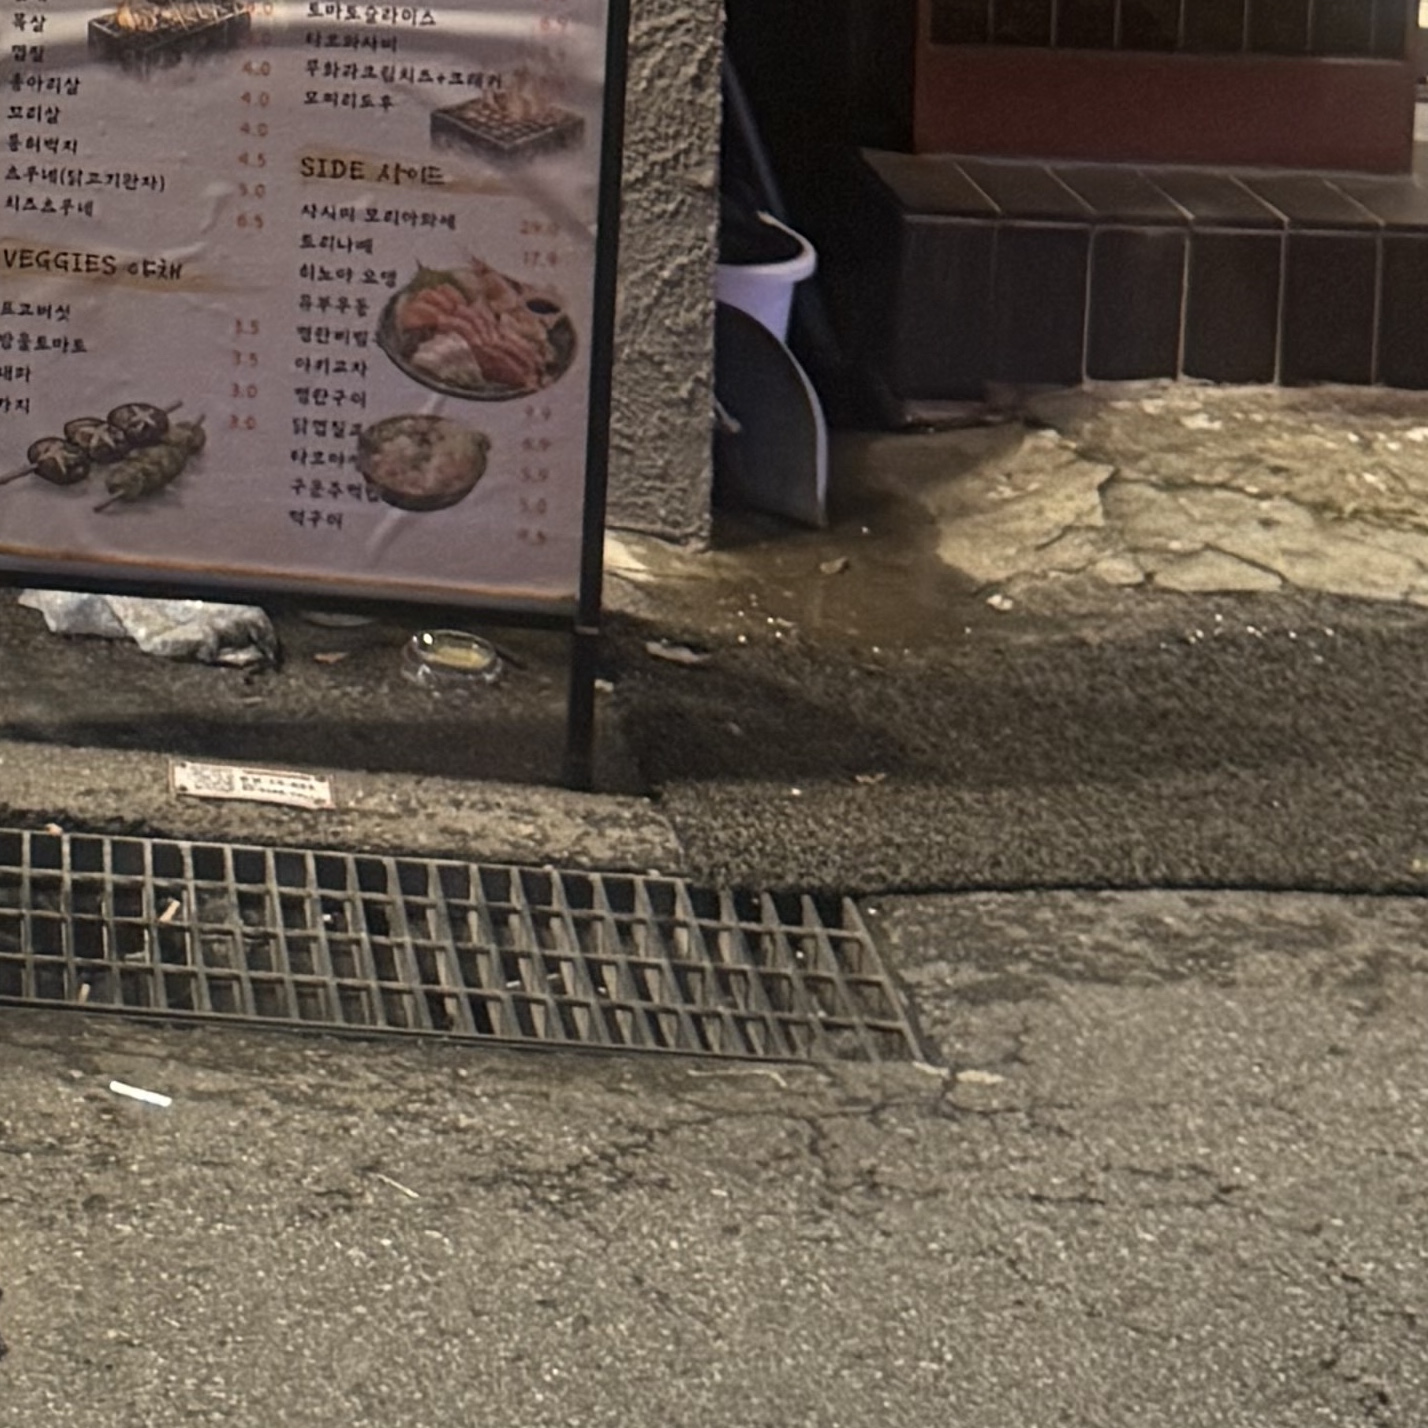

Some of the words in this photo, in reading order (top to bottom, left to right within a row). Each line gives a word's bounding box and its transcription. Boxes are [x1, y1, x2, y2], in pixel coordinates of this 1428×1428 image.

[307, 3, 437, 27] 토마토슬라이스
[300, 156, 365, 181] SIDE
[377, 162, 445, 186] 사이드
[3, 248, 117, 276] VEGGIES
[127, 258, 183, 280] 야채
